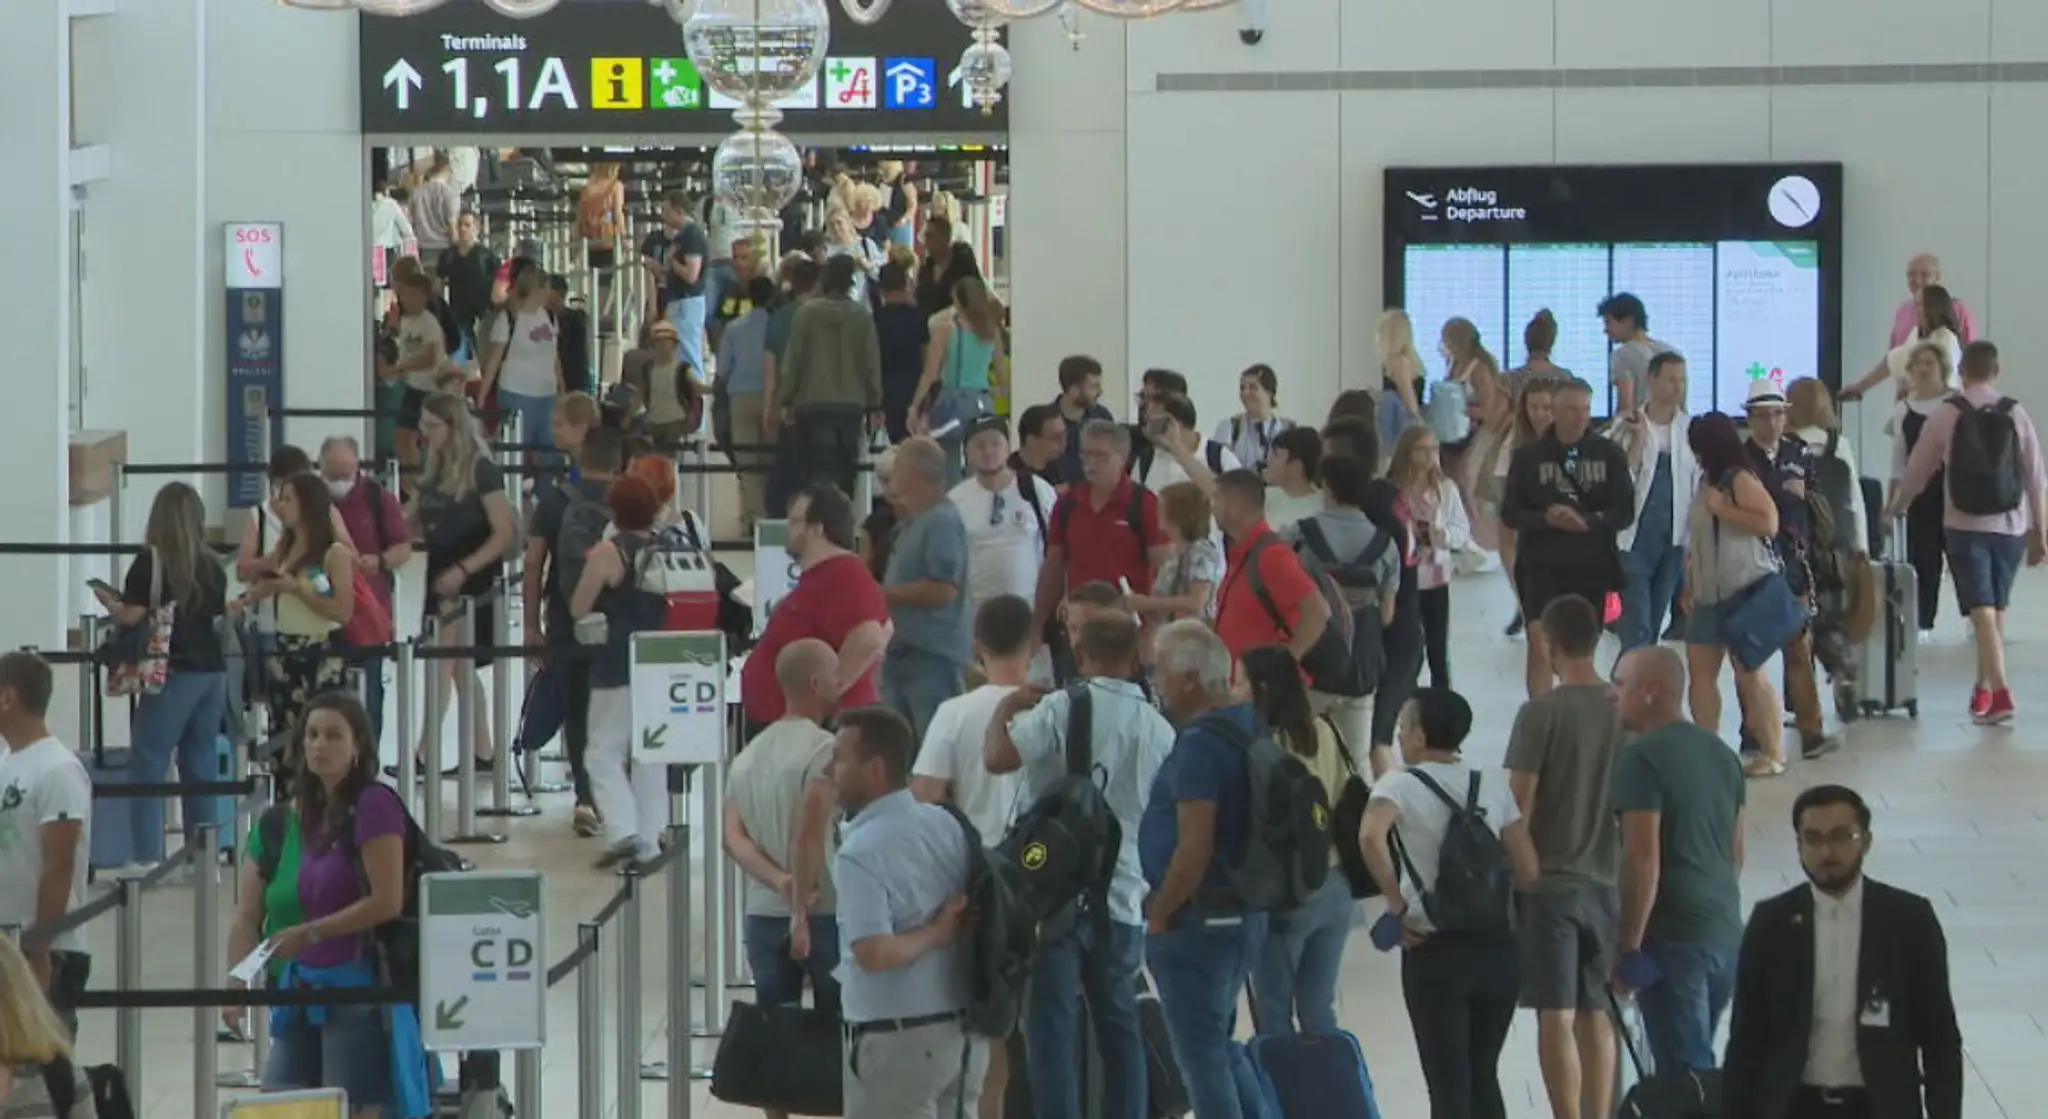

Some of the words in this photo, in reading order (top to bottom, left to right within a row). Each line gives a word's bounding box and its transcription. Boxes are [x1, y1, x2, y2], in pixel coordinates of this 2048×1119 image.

[441, 33, 527, 50] Terminals
[1446, 187, 1498, 205] Abflug
[1446, 206, 1526, 223] Departure
[236, 229, 271, 243] SOS
[669, 682, 687, 703] C
[696, 681, 716, 703] D
[471, 939, 495, 968] C
[507, 938, 533, 967] D
